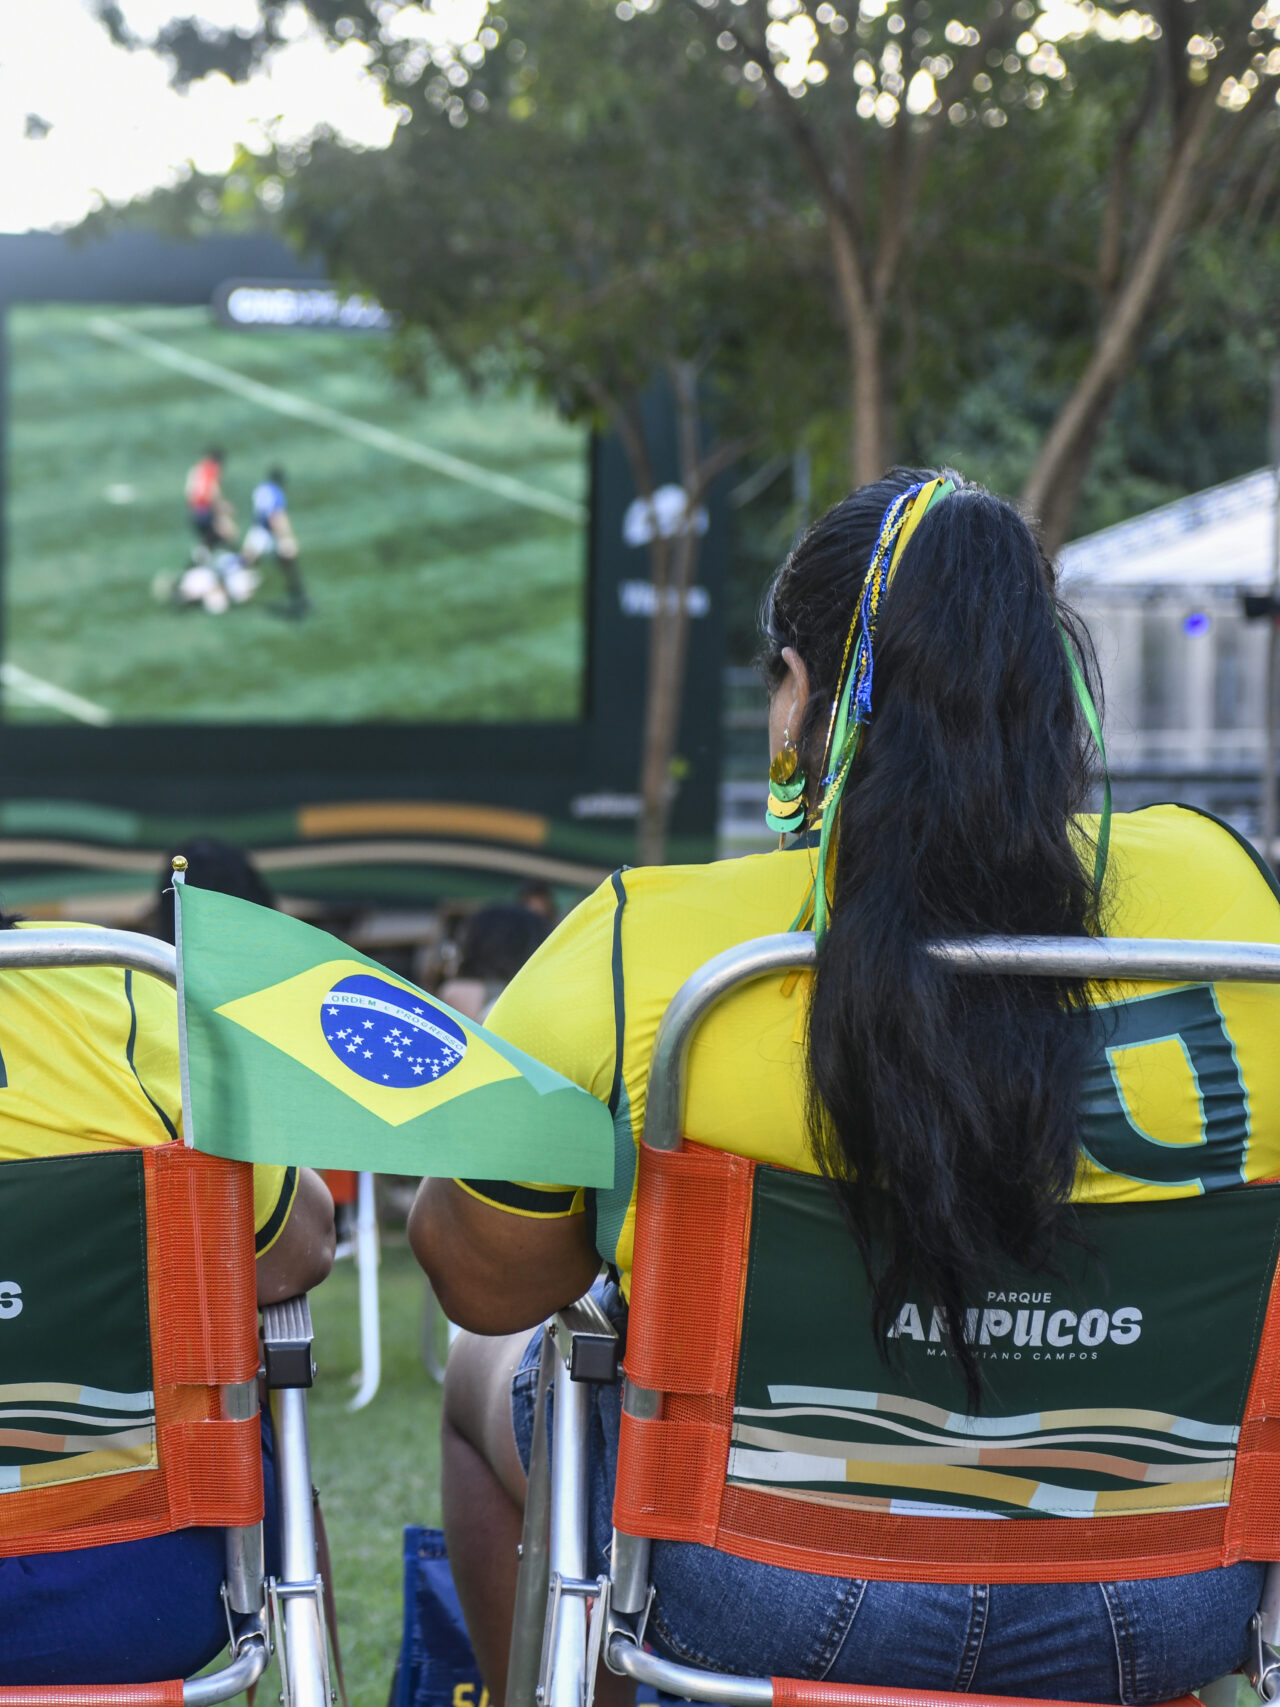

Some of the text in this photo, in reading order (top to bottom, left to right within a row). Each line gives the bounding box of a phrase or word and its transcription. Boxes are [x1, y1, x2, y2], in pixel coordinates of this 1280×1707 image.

[331, 994, 377, 1008] ORDEM
[396, 1008, 465, 1051] PROGRESSO
[987, 1291, 1052, 1304] PARQUE
[1032, 1351, 1099, 1361] CAMPOS
